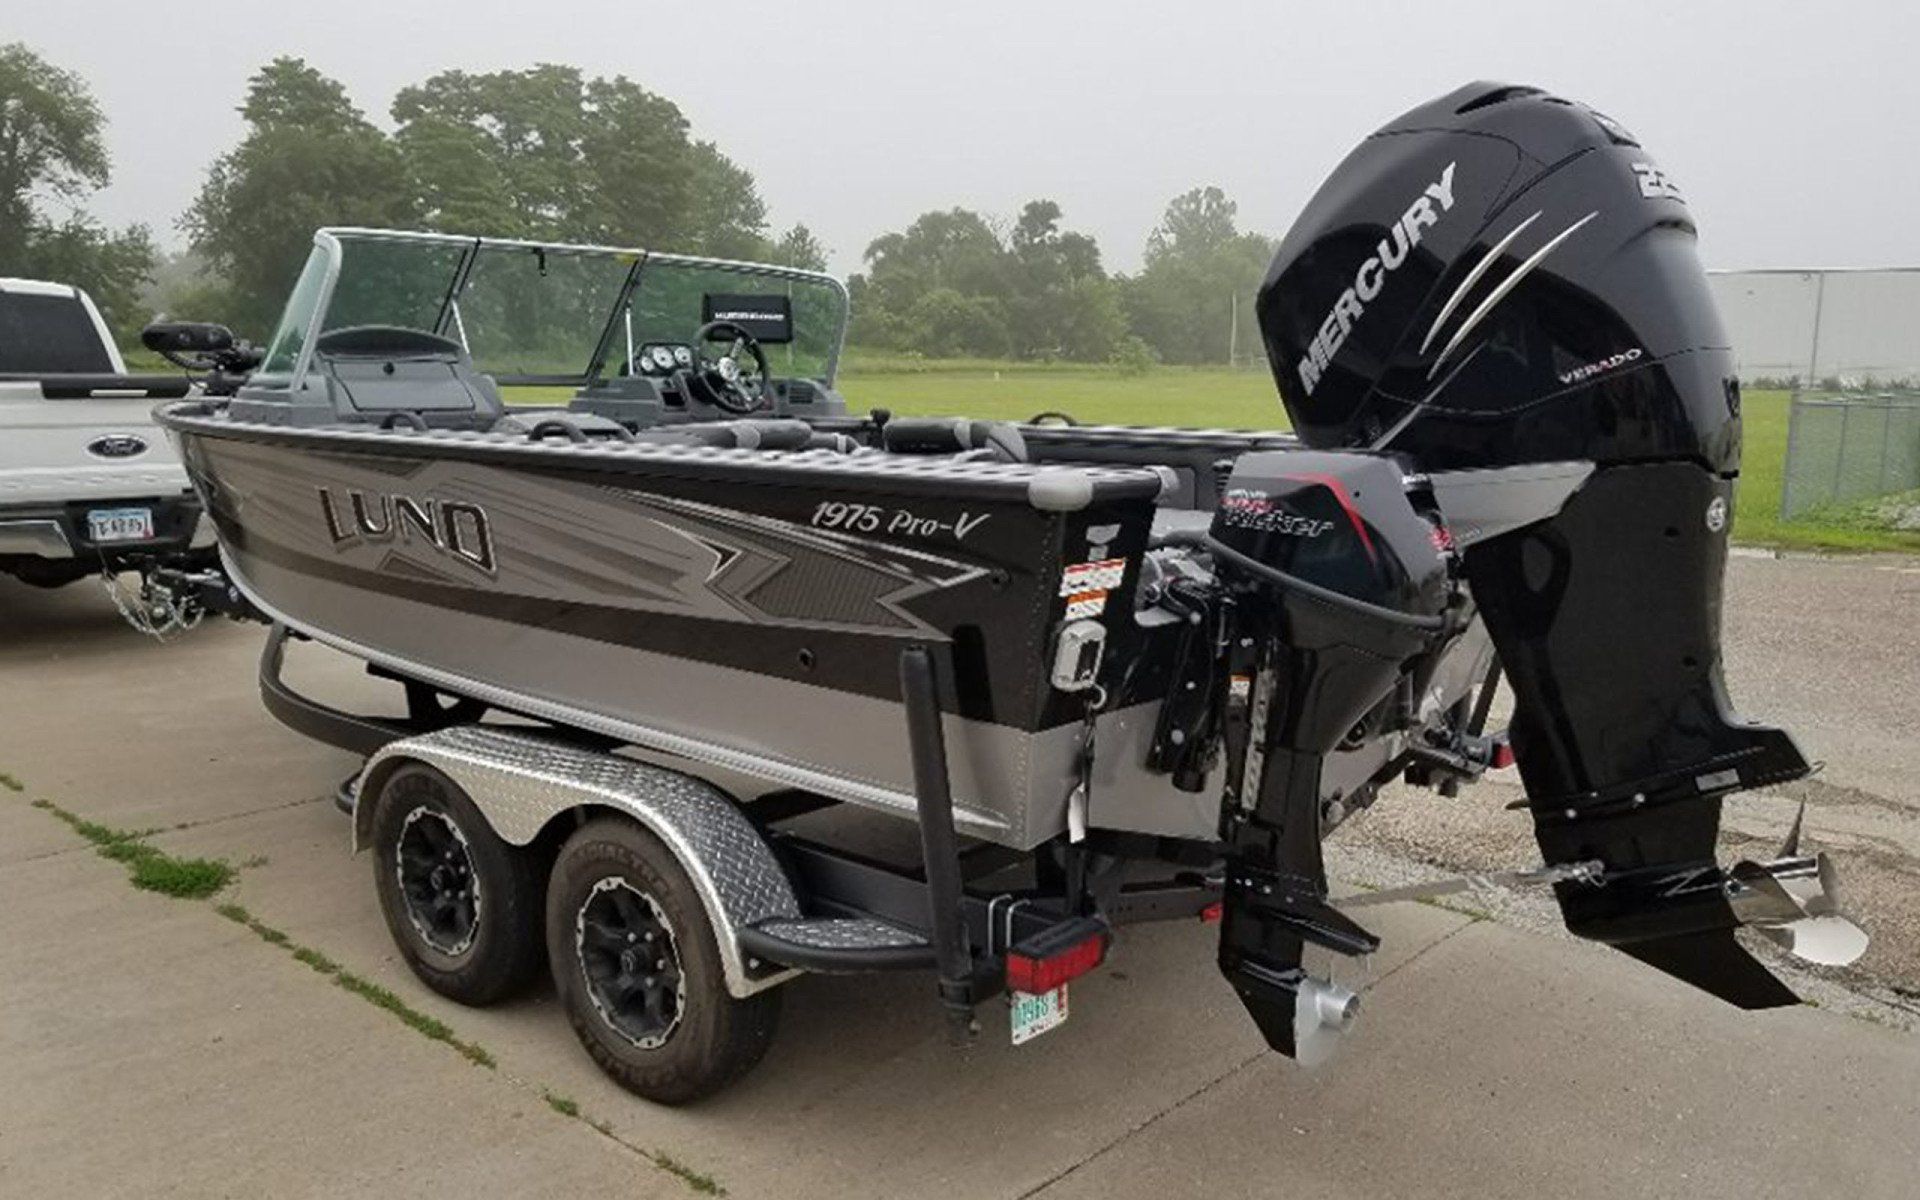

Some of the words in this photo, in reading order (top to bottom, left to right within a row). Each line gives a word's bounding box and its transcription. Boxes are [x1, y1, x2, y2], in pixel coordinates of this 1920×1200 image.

[1298, 161, 1456, 396] MERCURY
[1558, 348, 1642, 384] VERADO
[315, 485, 497, 575] LUND
[811, 501, 885, 532] 1975
[887, 509, 992, 541] Pro-V
